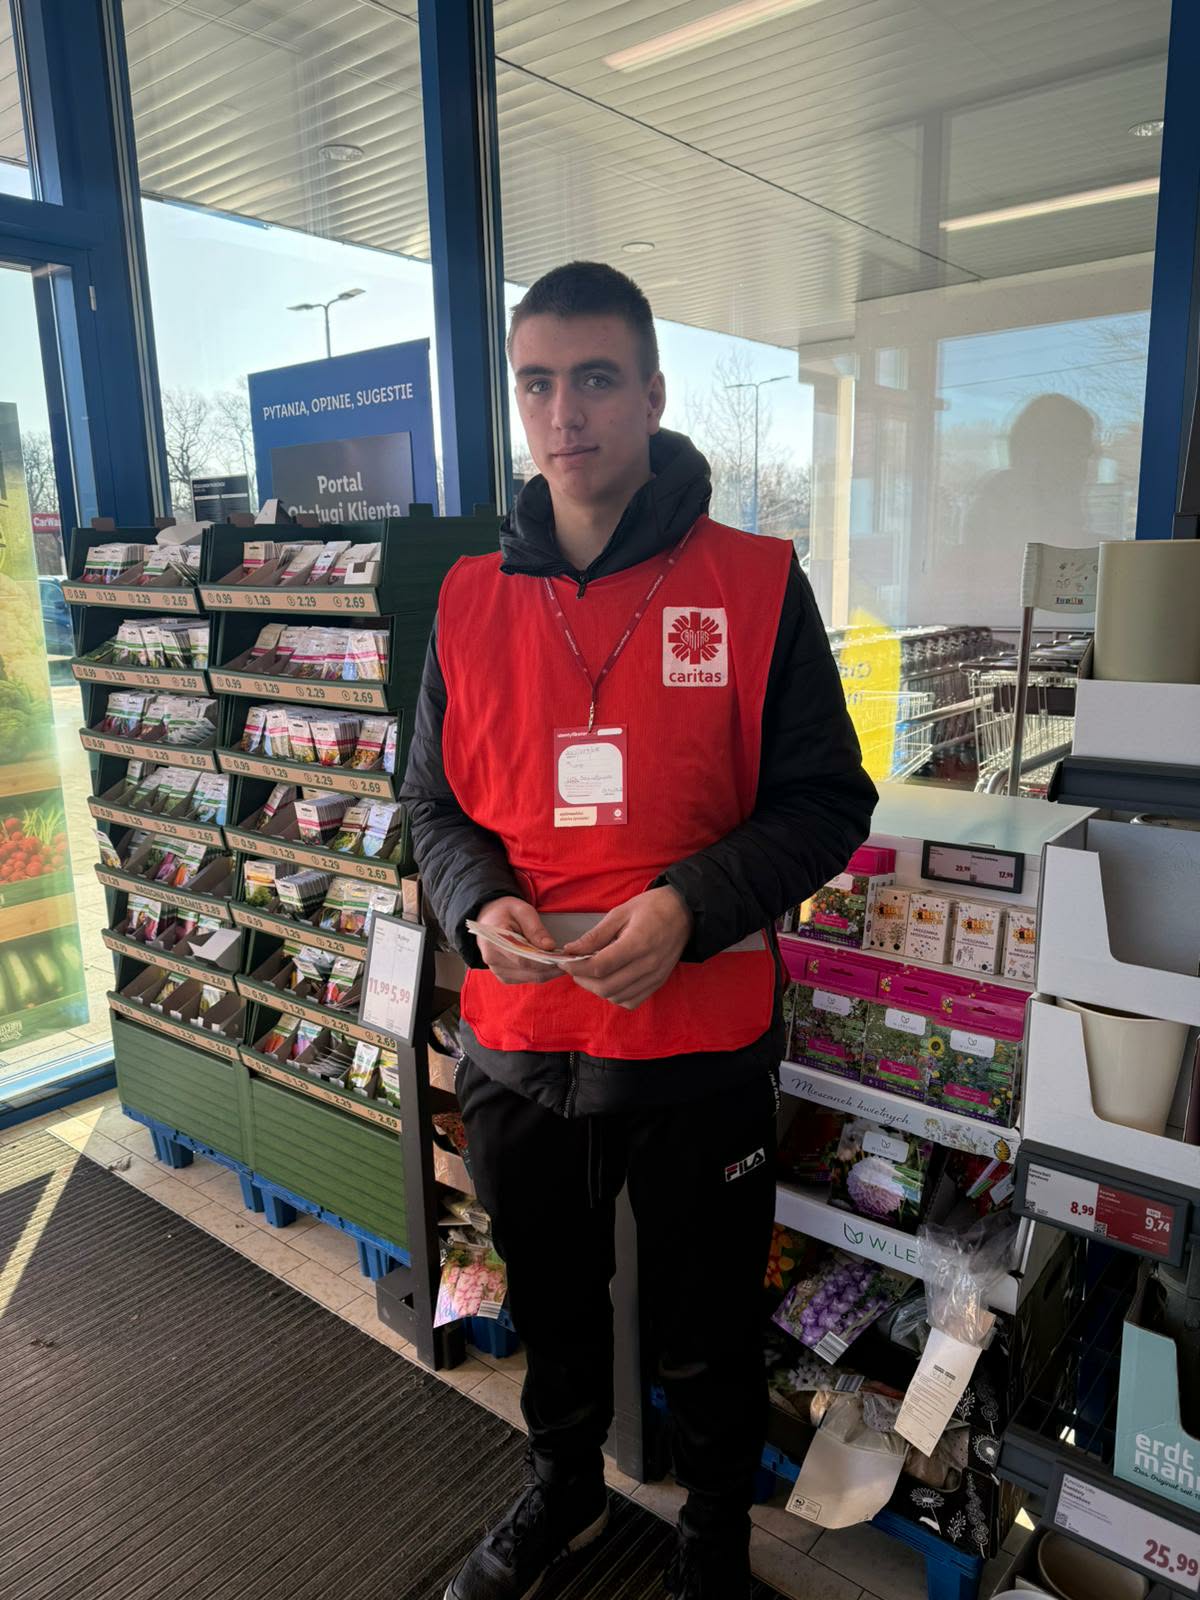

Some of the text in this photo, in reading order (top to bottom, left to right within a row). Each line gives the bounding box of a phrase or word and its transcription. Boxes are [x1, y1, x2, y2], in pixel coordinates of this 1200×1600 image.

[263, 383, 413, 420] PYTANIA, OPINIE, SUGESTIE
[317, 472, 364, 494] Portal
[348, 502, 401, 522] Klienta
[216, 594, 365, 609] 0.99 1.29 2.29 2.69
[226, 678, 374, 704] 0.99 1.29 2.29 2.69
[669, 669, 722, 683] caritas
[234, 760, 381, 793] 0.99 1.29 2.29 2.69
[241, 840, 388, 880] 0.99 1.29 2.29 2.69
[248, 916, 345, 952] 0.99 1.29 2.29
[390, 985, 410, 1004] 5.99
[252, 989, 396, 1048] 0.99 1.29 2.29 2.69
[724, 1147, 766, 1182] FILA
[1070, 1201, 1094, 1216] 8.99
[1145, 1218, 1170, 1233] 9.74
[869, 1234, 924, 1266] W.LE
[1136, 1434, 1194, 1471] erdt
[1134, 1449, 1200, 1491] man
[1150, 1474, 1180, 1490] Original
[1143, 1538, 1200, 1577] 25.99
